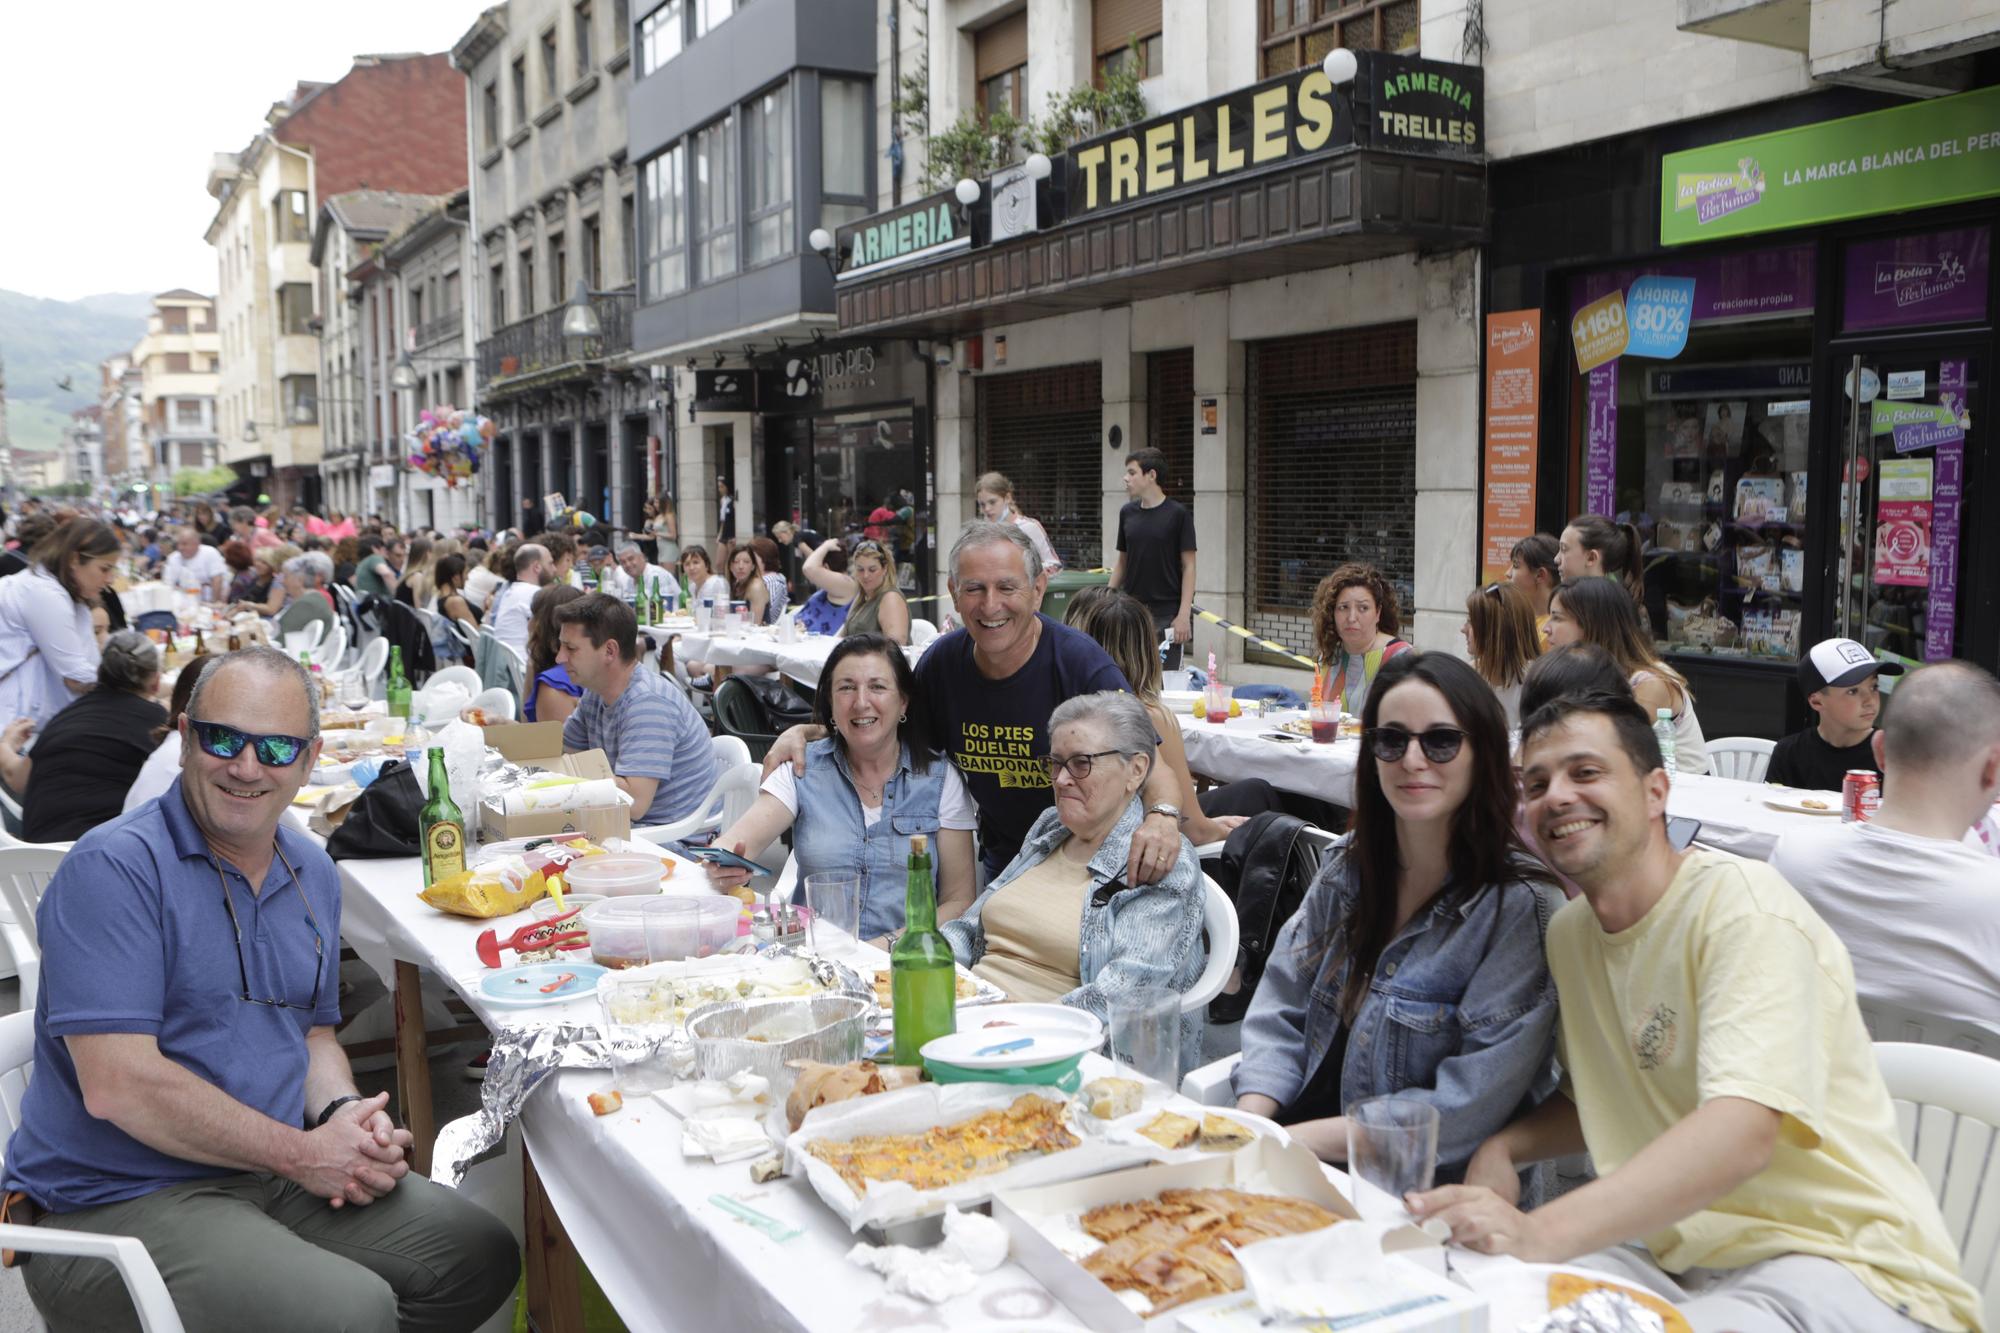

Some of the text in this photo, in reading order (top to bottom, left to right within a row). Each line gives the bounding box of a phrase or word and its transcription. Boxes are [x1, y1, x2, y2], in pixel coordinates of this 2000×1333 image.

[1384, 72, 1472, 112] ARMERIA
[1078, 71, 1333, 209] TRELLES
[1379, 110, 1476, 145] TRELLES
[1783, 169, 1802, 186] LA
[1805, 160, 1857, 181] MARCA
[1861, 145, 1926, 172] BLANCA
[1929, 139, 1963, 160] DEL
[851, 202, 954, 269] ARMERIA
[1634, 287, 1688, 305] AHORRA
[1712, 292, 1794, 312] creaciones propias
[1574, 302, 1623, 341] +160
[1634, 303, 1685, 334] 80%
[1898, 423, 1959, 447] Perfumes
[962, 722, 1034, 742] LOS PIES
[965, 739, 1031, 757] DUELEN
